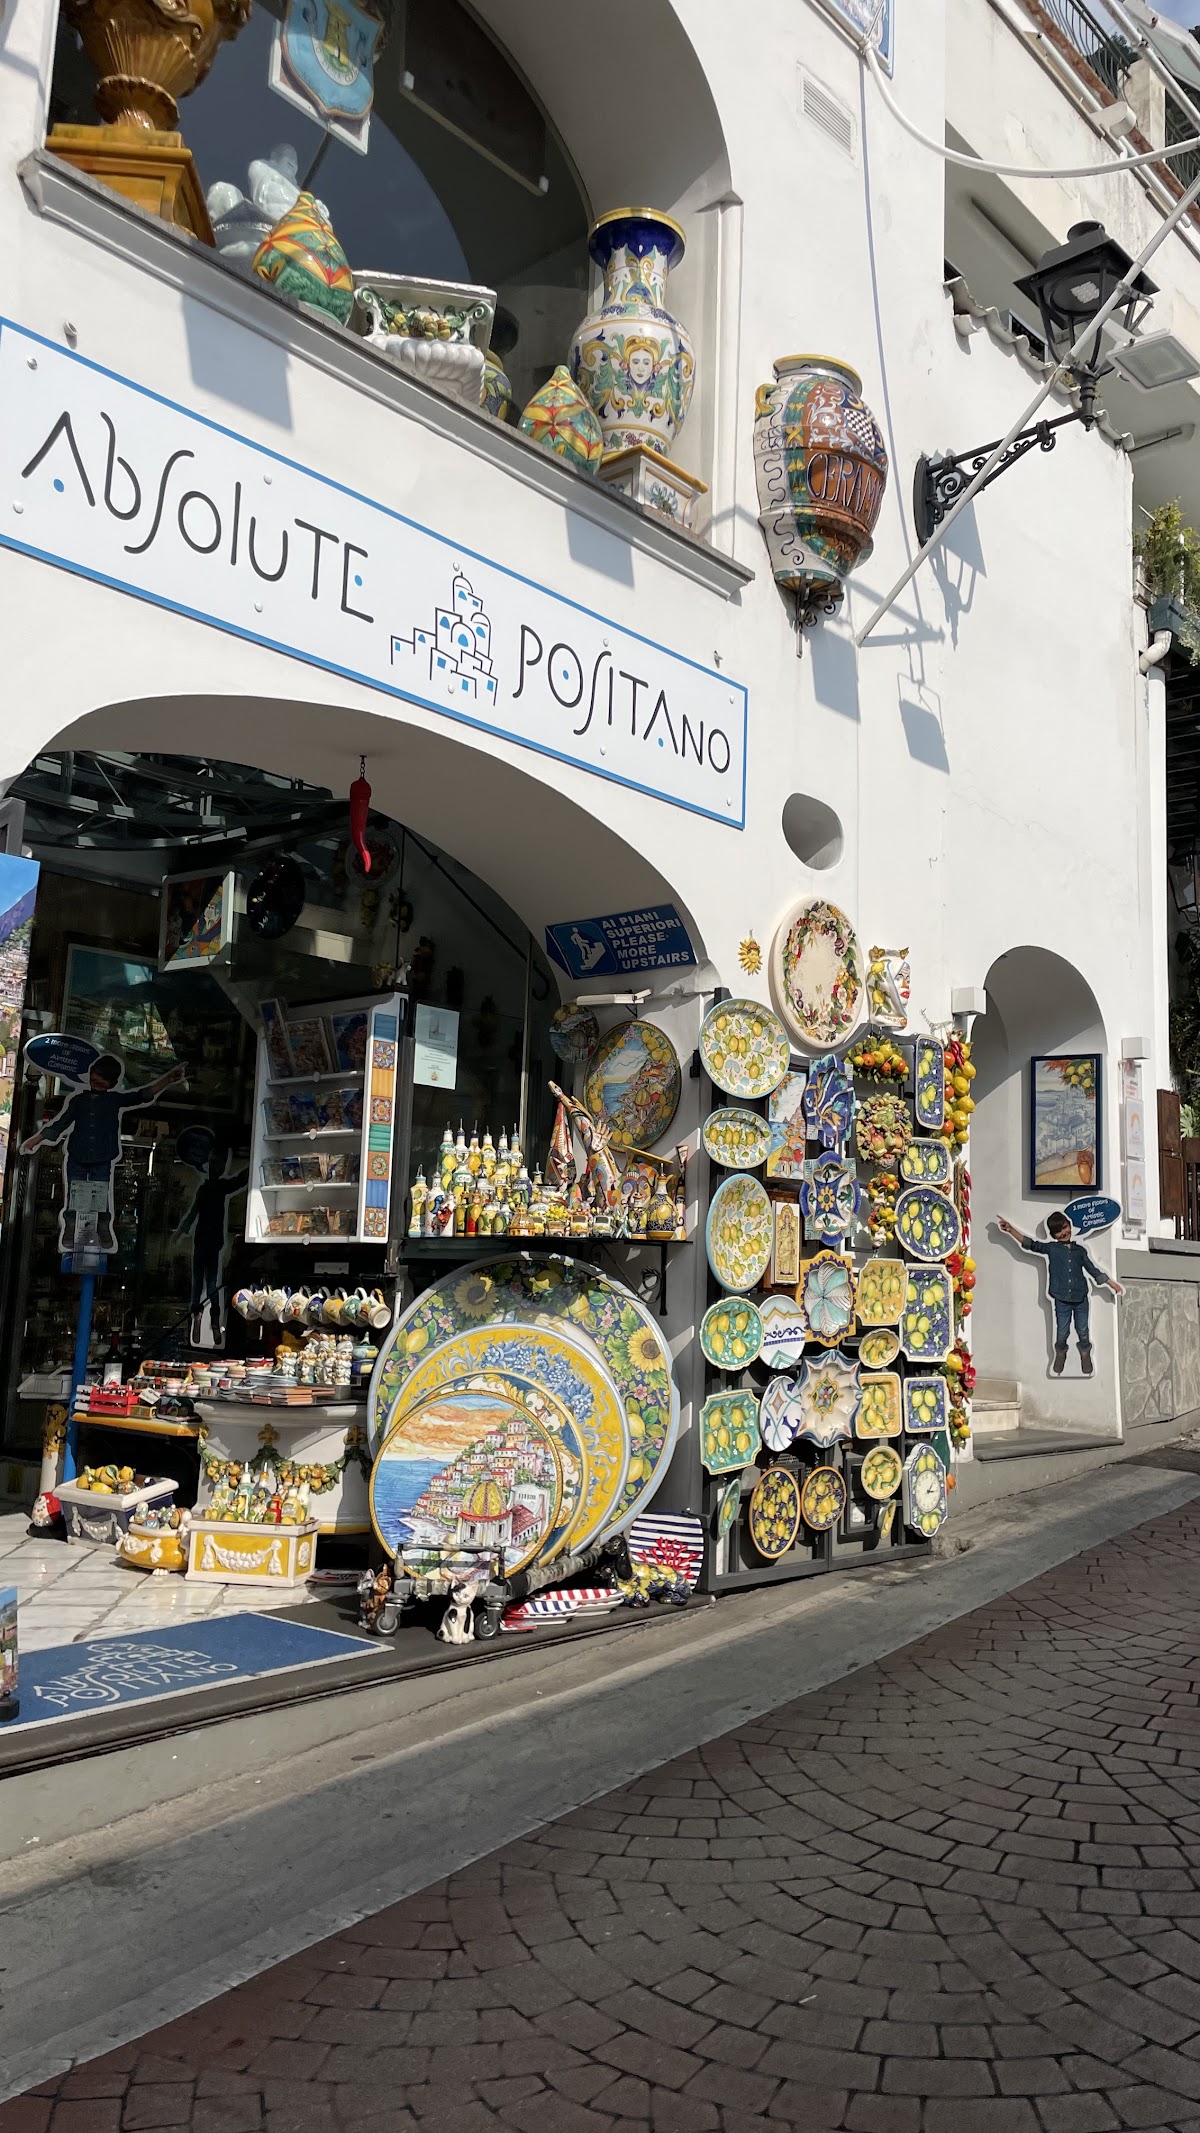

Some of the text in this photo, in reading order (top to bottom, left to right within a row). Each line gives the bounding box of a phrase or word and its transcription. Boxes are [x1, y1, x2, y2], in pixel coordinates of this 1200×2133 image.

[513, 624, 731, 774] POSITANO
[602, 911, 660, 929] AI PIANI
[606, 918, 682, 939] SUPERIORI
[612, 931, 667, 949] PLEASE
[617, 944, 657, 960] MORE
[621, 951, 690, 970] UPSTAIRS
[50, 1038, 69, 1048] more
[1077, 1201, 1092, 1210] more
[1081, 1211, 1105, 1221] Artistic
[1082, 1217, 1107, 1228] Ceramic
